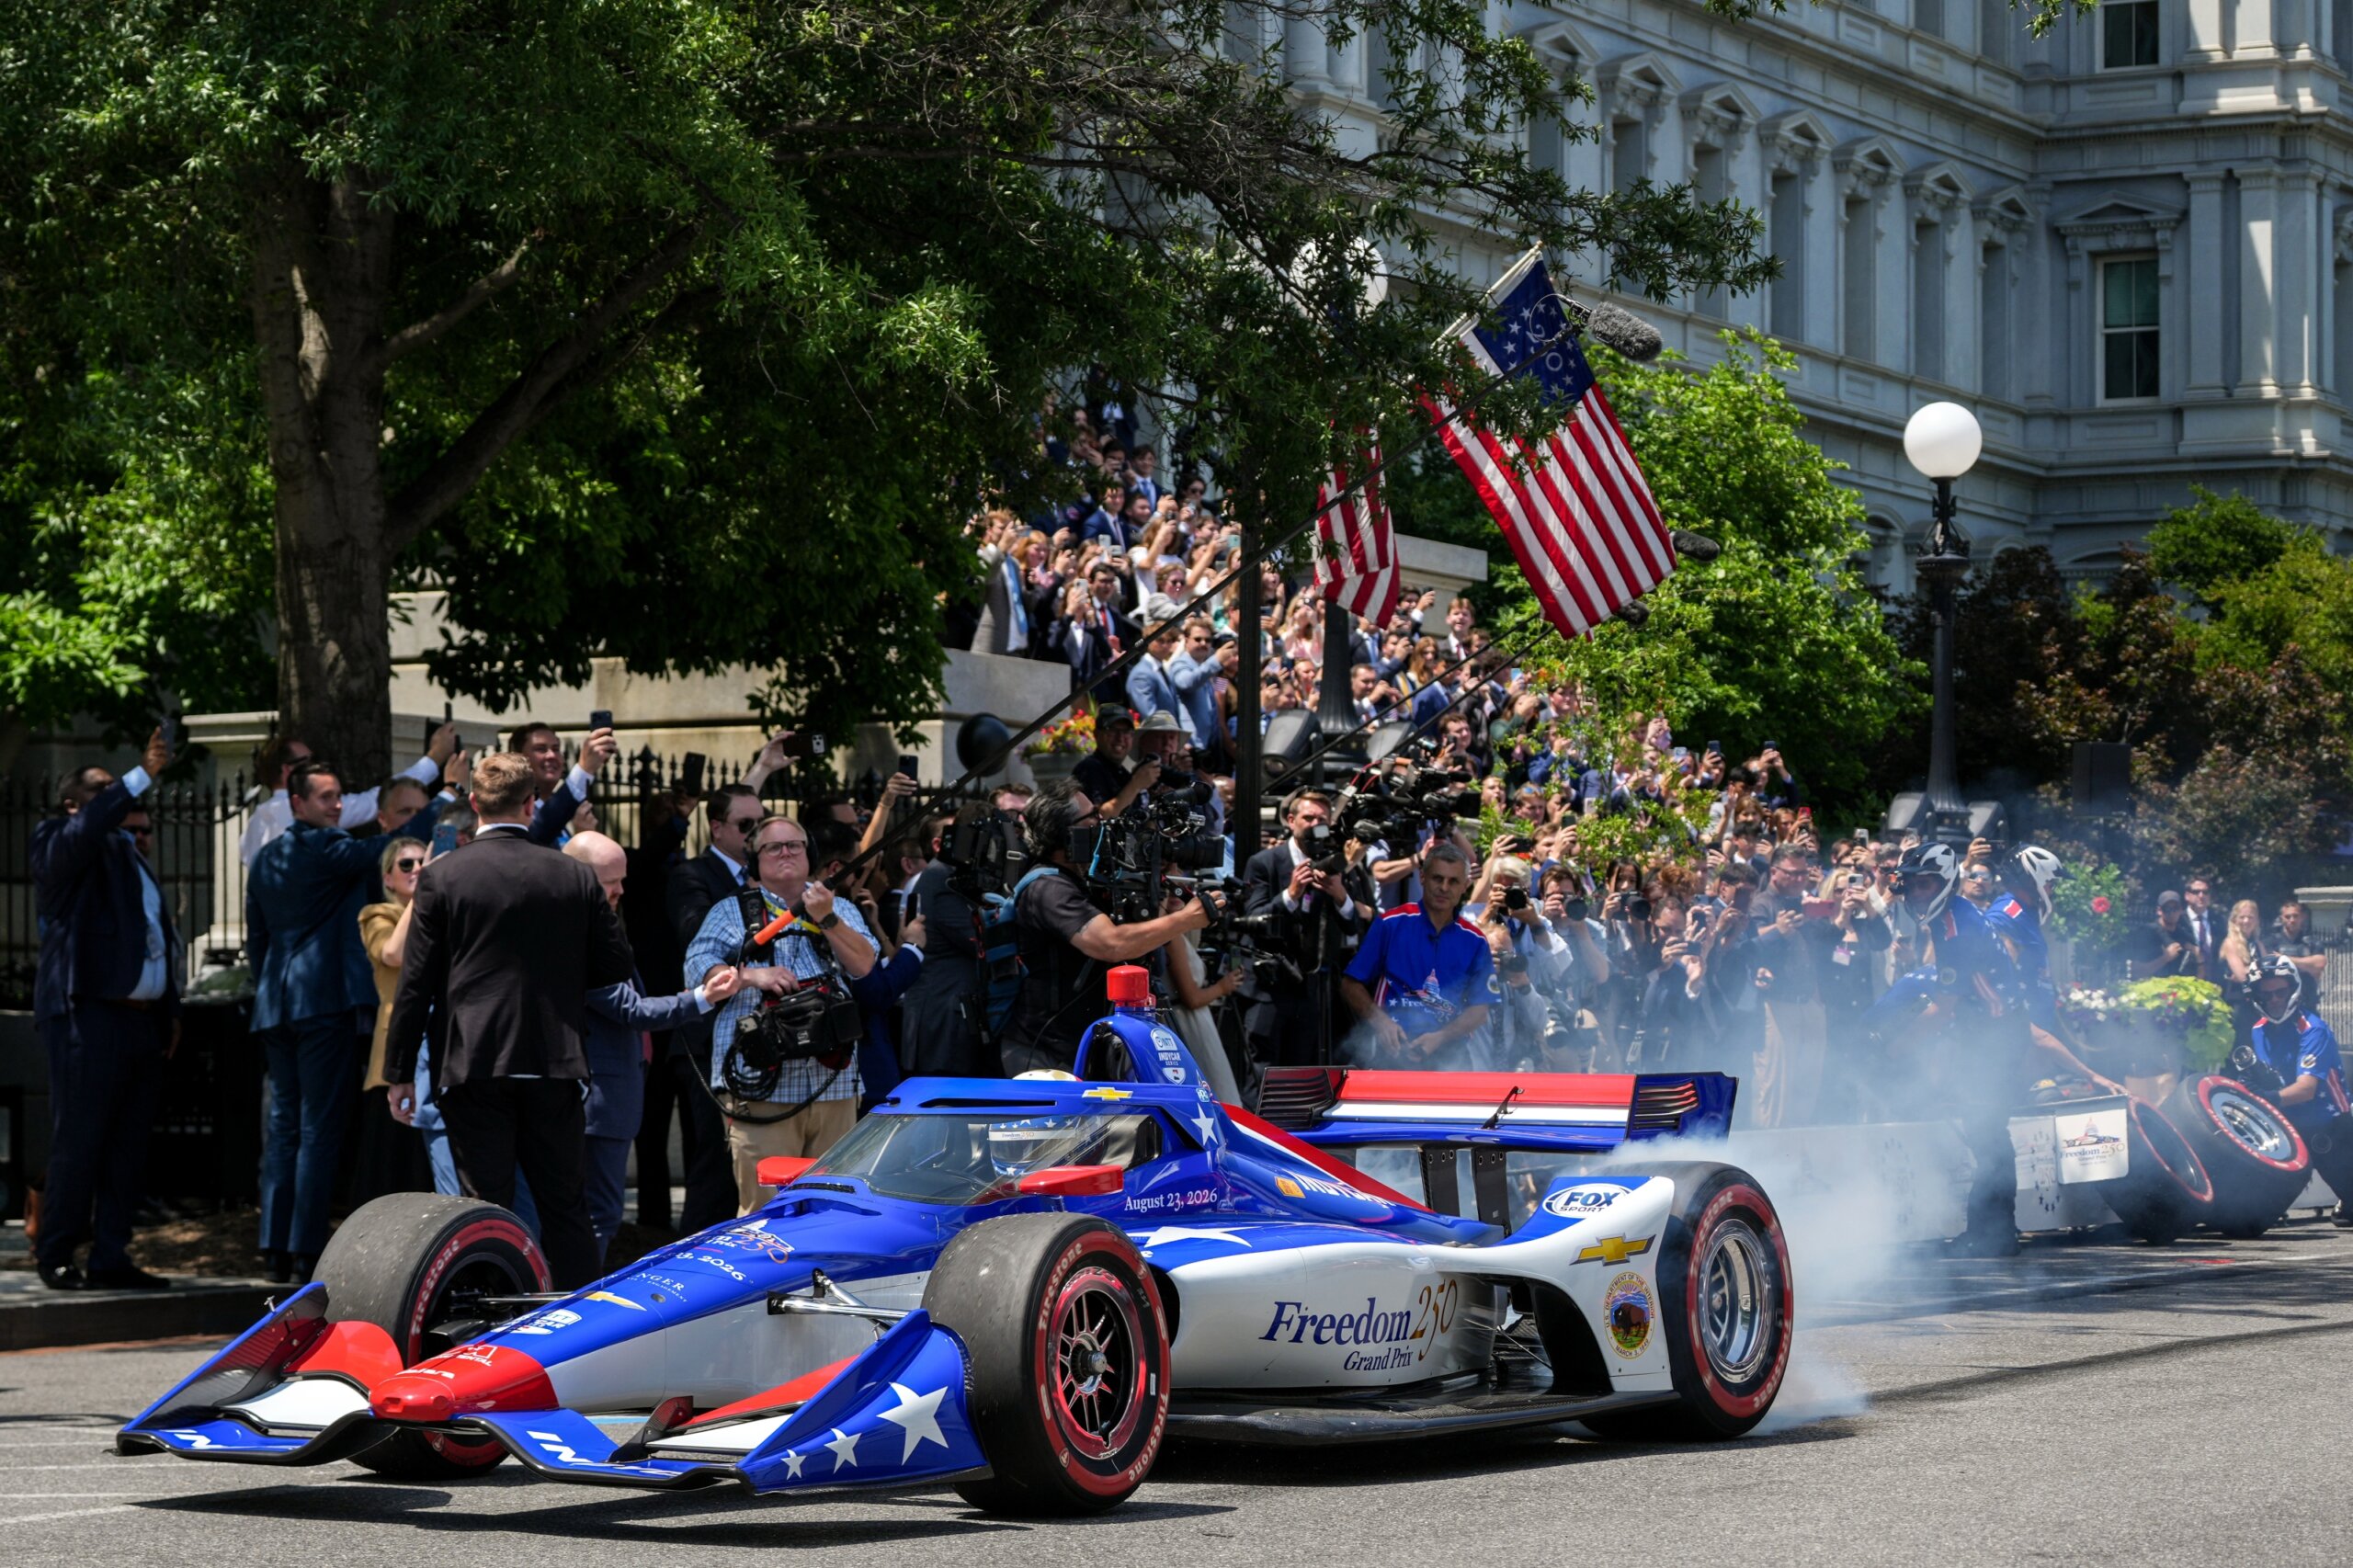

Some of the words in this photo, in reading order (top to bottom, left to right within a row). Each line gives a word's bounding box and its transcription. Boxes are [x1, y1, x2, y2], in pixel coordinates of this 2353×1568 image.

[1158, 1052, 1181, 1061] INDYCAR
[1125, 1196, 1165, 1213] August
[1166, 1192, 1185, 1211] 23,
[1187, 1189, 1218, 1205] 2026
[1563, 1191, 1621, 1207] FOX
[697, 1256, 746, 1280] 2026
[411, 1241, 460, 1335] Firestone
[1038, 1243, 1083, 1332] Firestone
[1605, 1274, 1627, 1311] DEPARTMENT
[1258, 1297, 1411, 1346] Freedom
[1409, 1278, 1458, 1361] 250
[1343, 1347, 1391, 1371] Grand
[1392, 1345, 1413, 1369] Prix
[1128, 1392, 1169, 1482] Firestone
